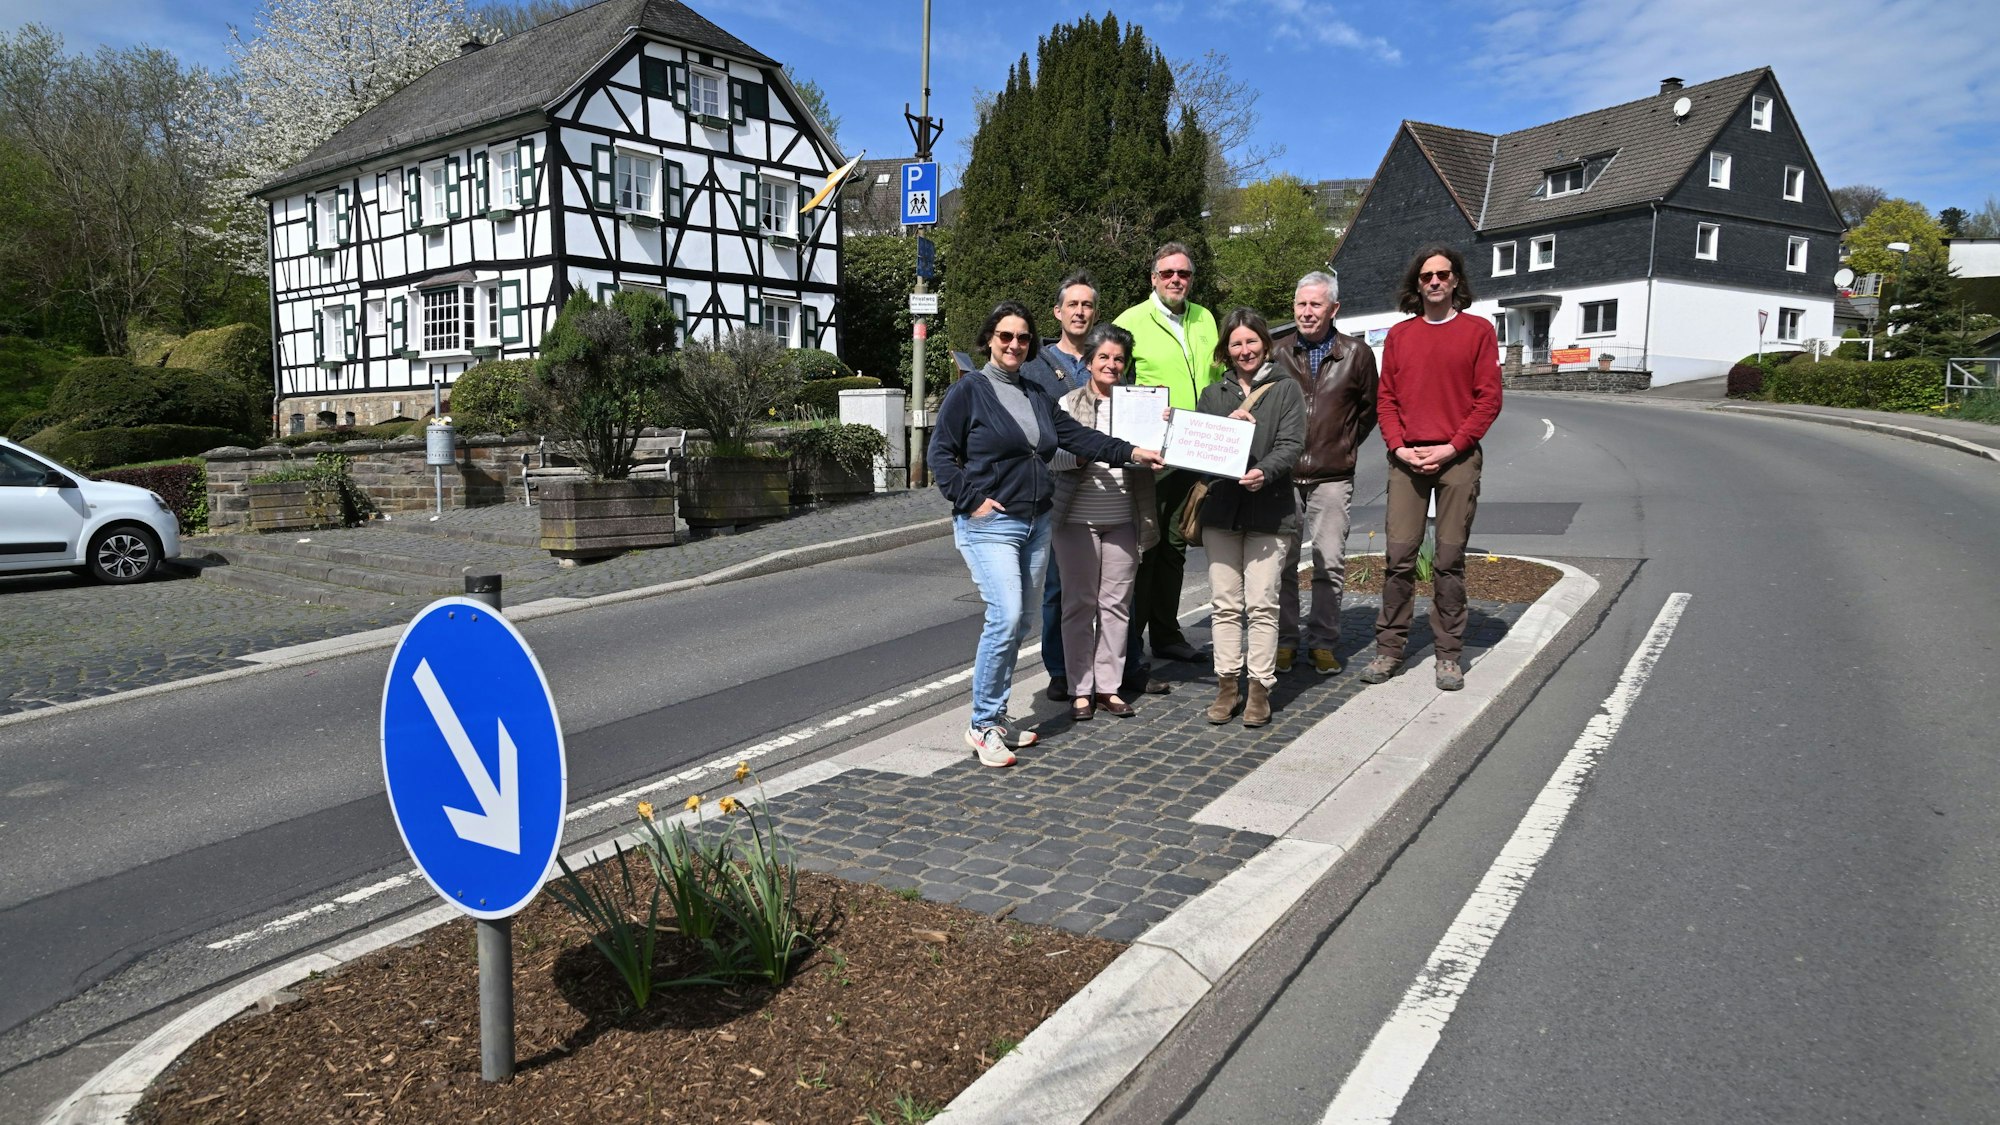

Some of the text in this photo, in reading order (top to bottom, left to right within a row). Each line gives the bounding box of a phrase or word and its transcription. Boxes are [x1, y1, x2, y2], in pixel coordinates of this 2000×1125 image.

[907, 166, 923, 190] P
[1189, 418, 1204, 427] Wir
[1184, 427, 1240, 445] Tempo 30 auf
[1178, 437, 1240, 455] der Bergstraße
[1187, 448, 1227, 463] in Kürten!
